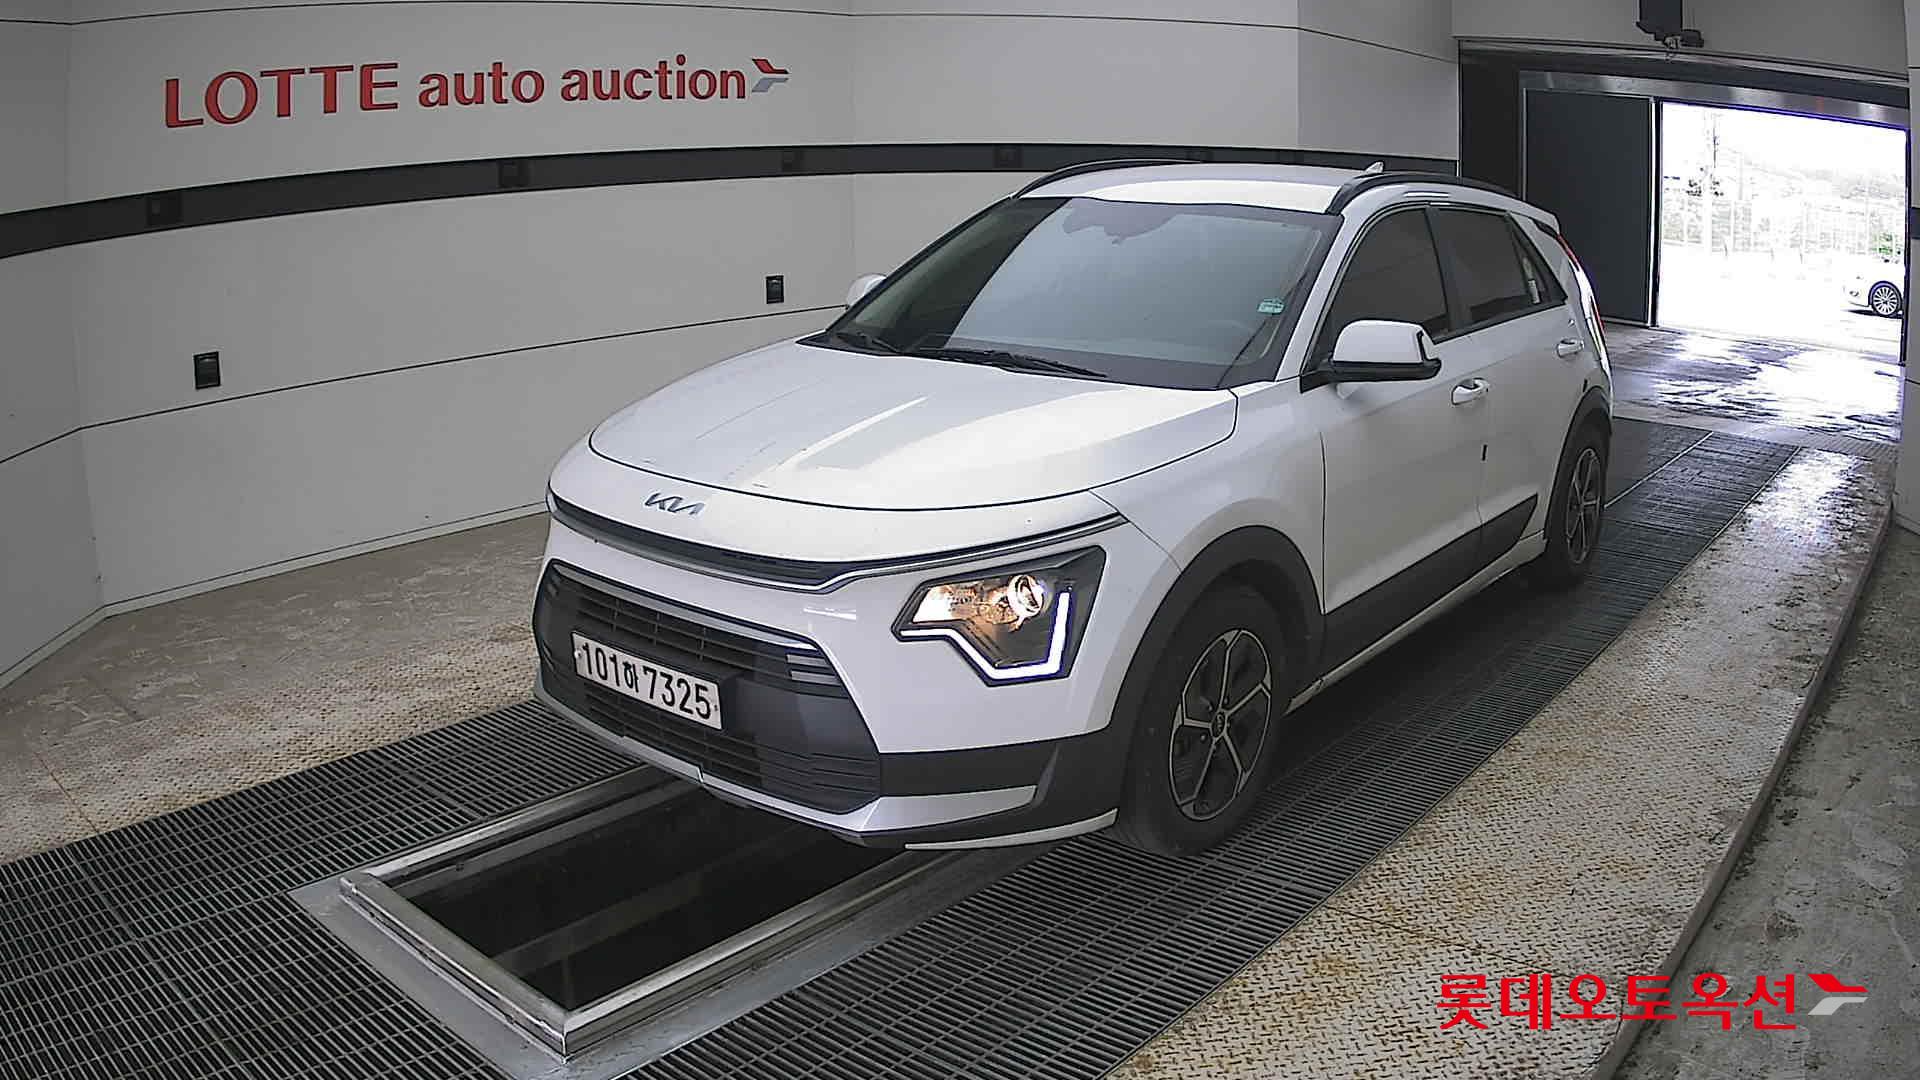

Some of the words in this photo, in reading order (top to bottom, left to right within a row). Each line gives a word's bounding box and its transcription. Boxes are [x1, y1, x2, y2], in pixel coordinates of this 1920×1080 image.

[165, 62, 400, 129] LOTTE
[418, 62, 545, 107] auto
[560, 54, 746, 101] auction
[644, 491, 705, 516] KIA
